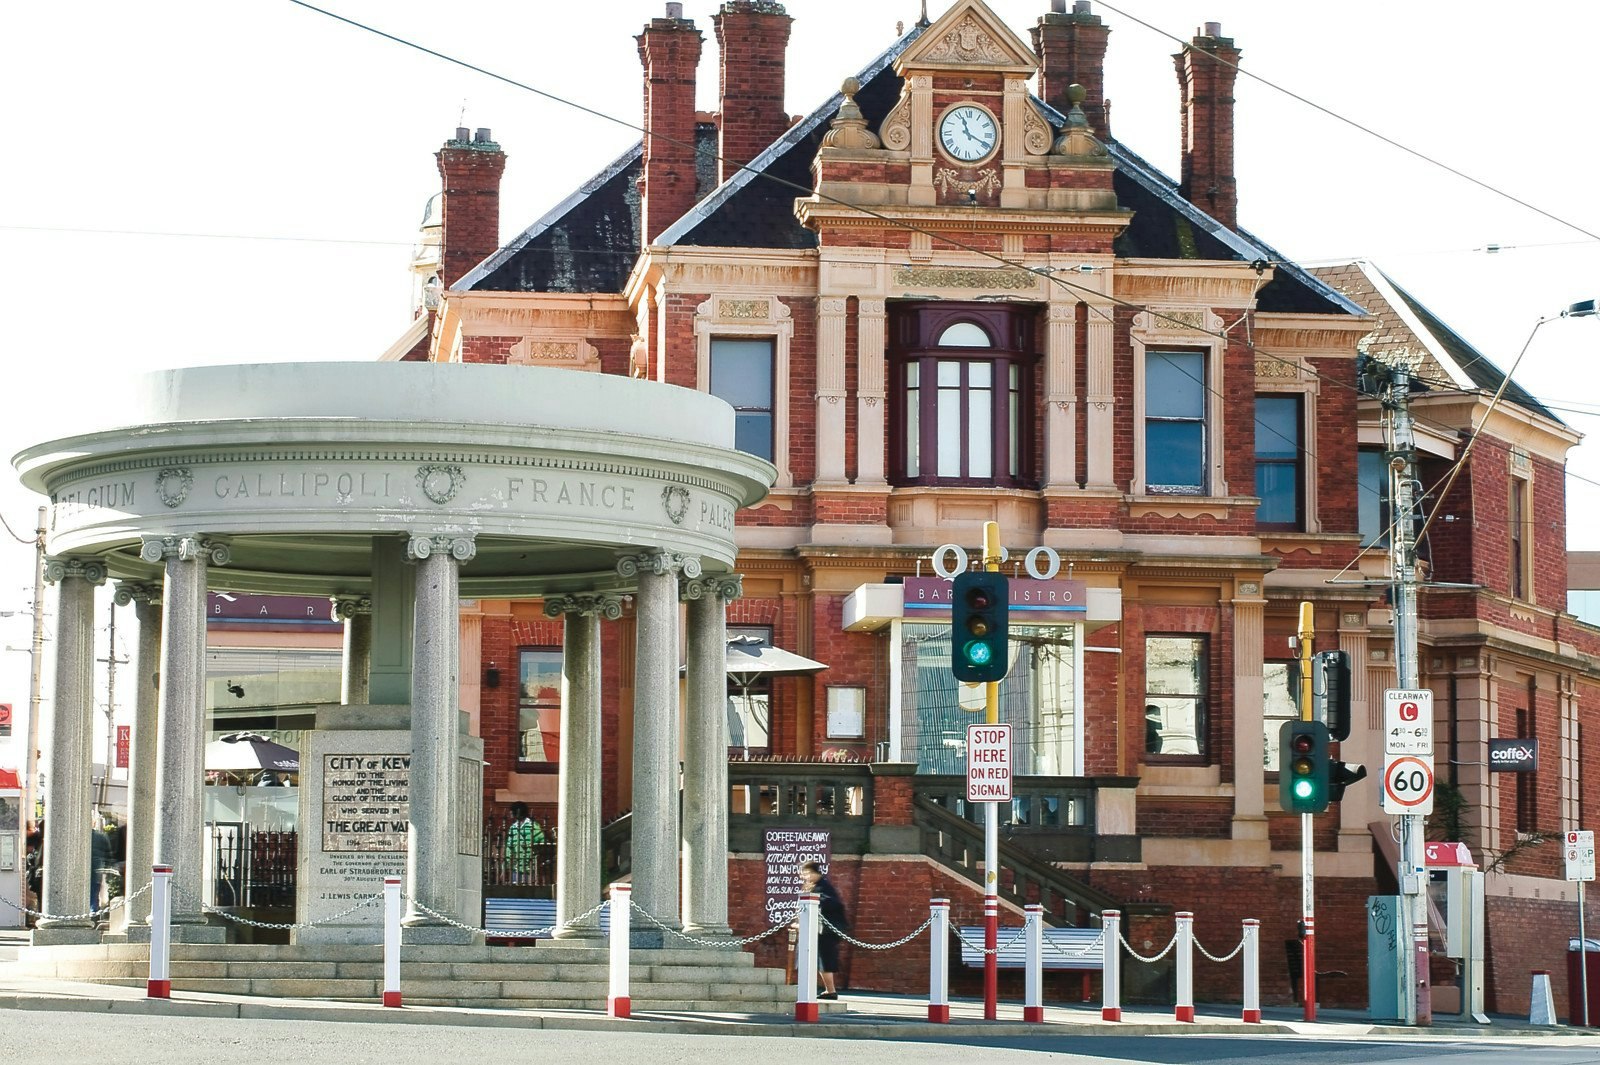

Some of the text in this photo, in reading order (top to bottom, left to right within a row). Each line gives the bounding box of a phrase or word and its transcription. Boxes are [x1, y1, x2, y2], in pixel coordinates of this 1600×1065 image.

[214, 472, 391, 499] GALLIPOLI
[506, 477, 635, 511] FRANCE
[932, 544, 1061, 582] QO
[918, 588, 1073, 602] BAR ISTRO
[215, 604, 314, 616] BAR
[974, 730, 1006, 744] STOP
[974, 749, 1007, 763] HERE
[330, 757, 411, 770] CITY OF KEW
[970, 768, 1008, 779] ON RED
[1393, 770, 1425, 792] 60
[970, 784, 1008, 796] SIGNAL
[327, 821, 351, 832] THE
[352, 821, 389, 832] GREAT
[765, 853, 826, 863] KITCHEN OPEN
